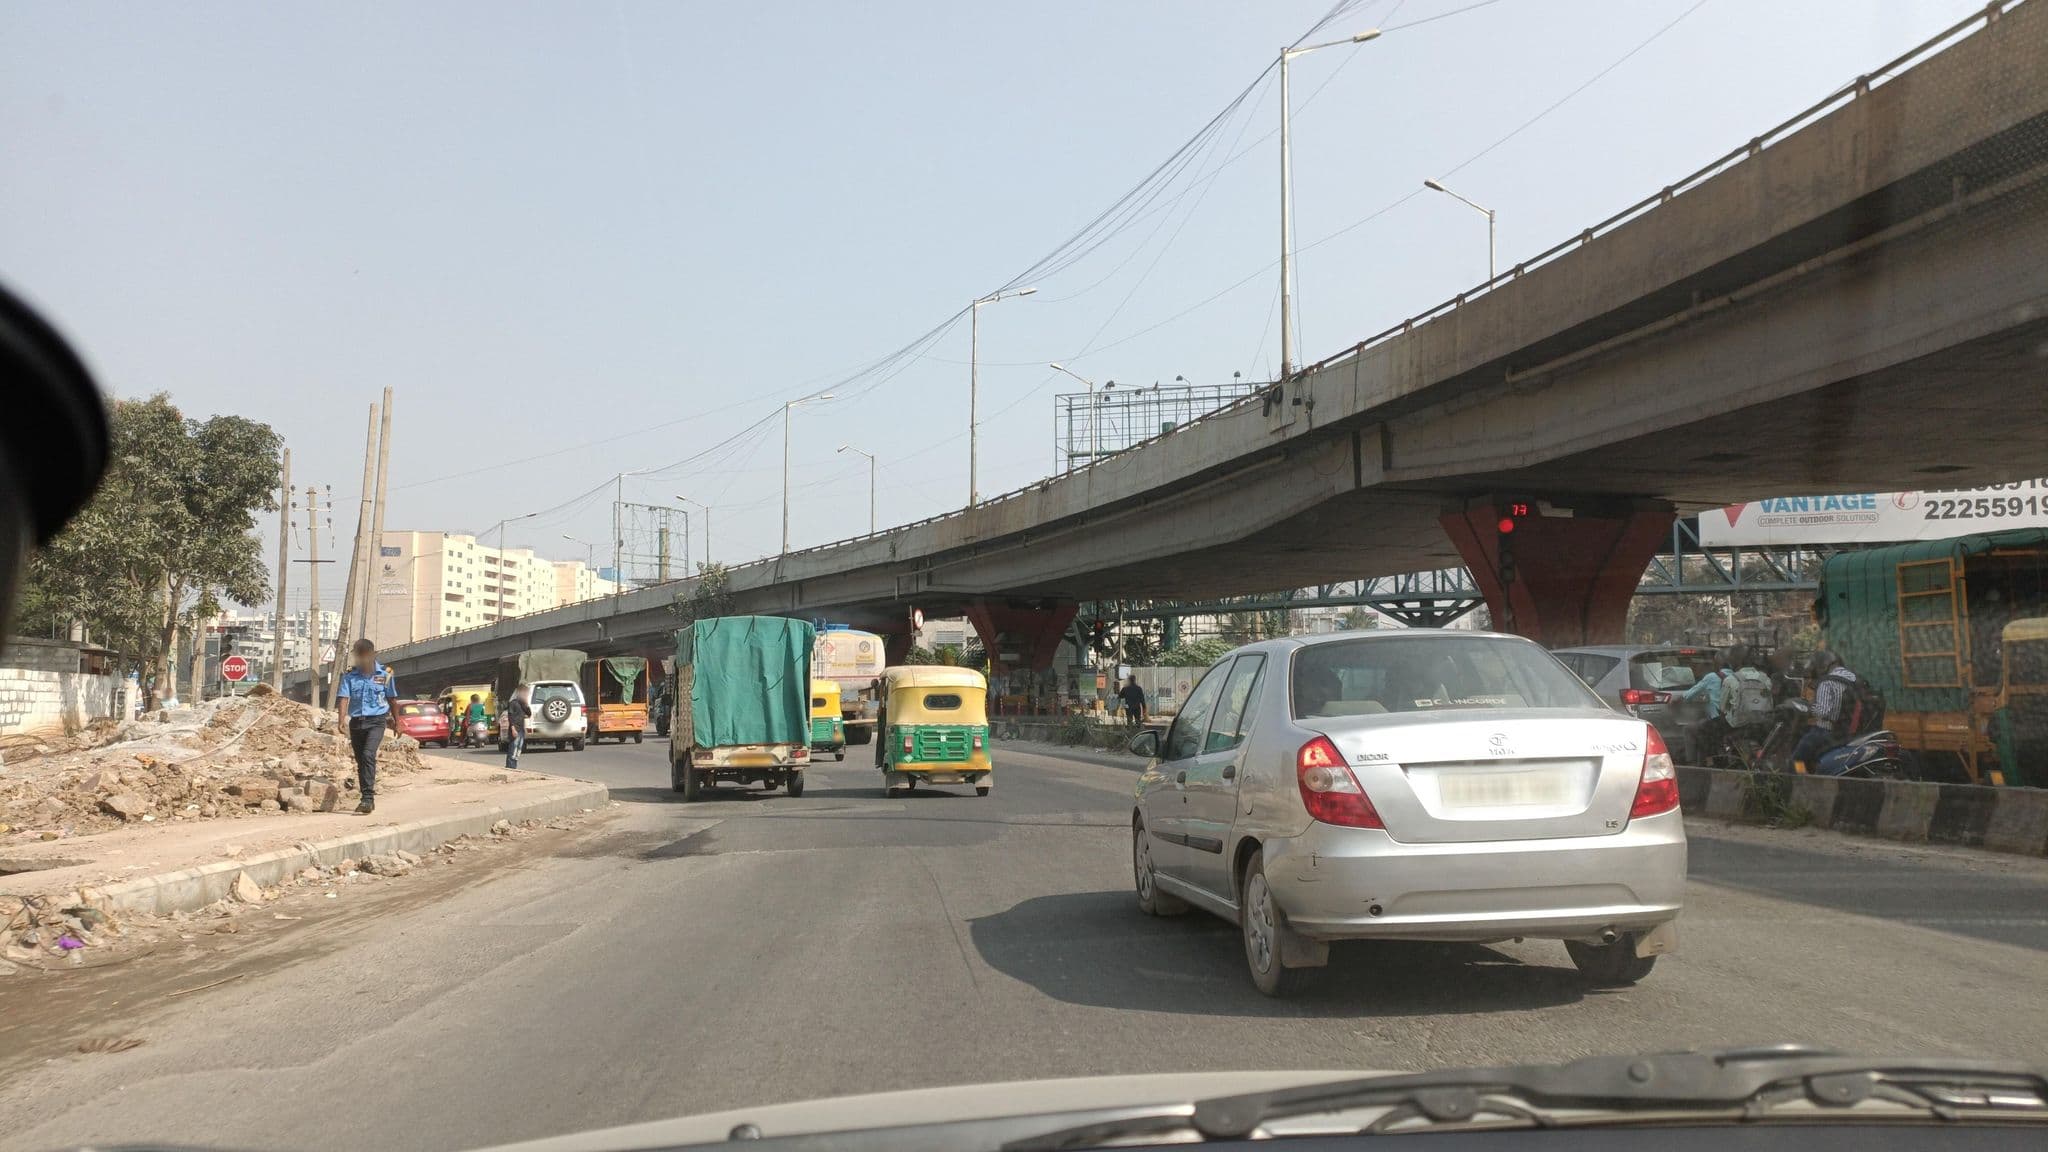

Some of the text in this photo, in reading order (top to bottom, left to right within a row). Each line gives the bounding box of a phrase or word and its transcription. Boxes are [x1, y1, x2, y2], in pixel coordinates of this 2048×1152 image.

[1760, 493, 1877, 513] VANTAGE
[1760, 513, 1876, 525] COMPLETE OUTDOOR SOLUTIONS
[224, 664, 246, 672] STOP
